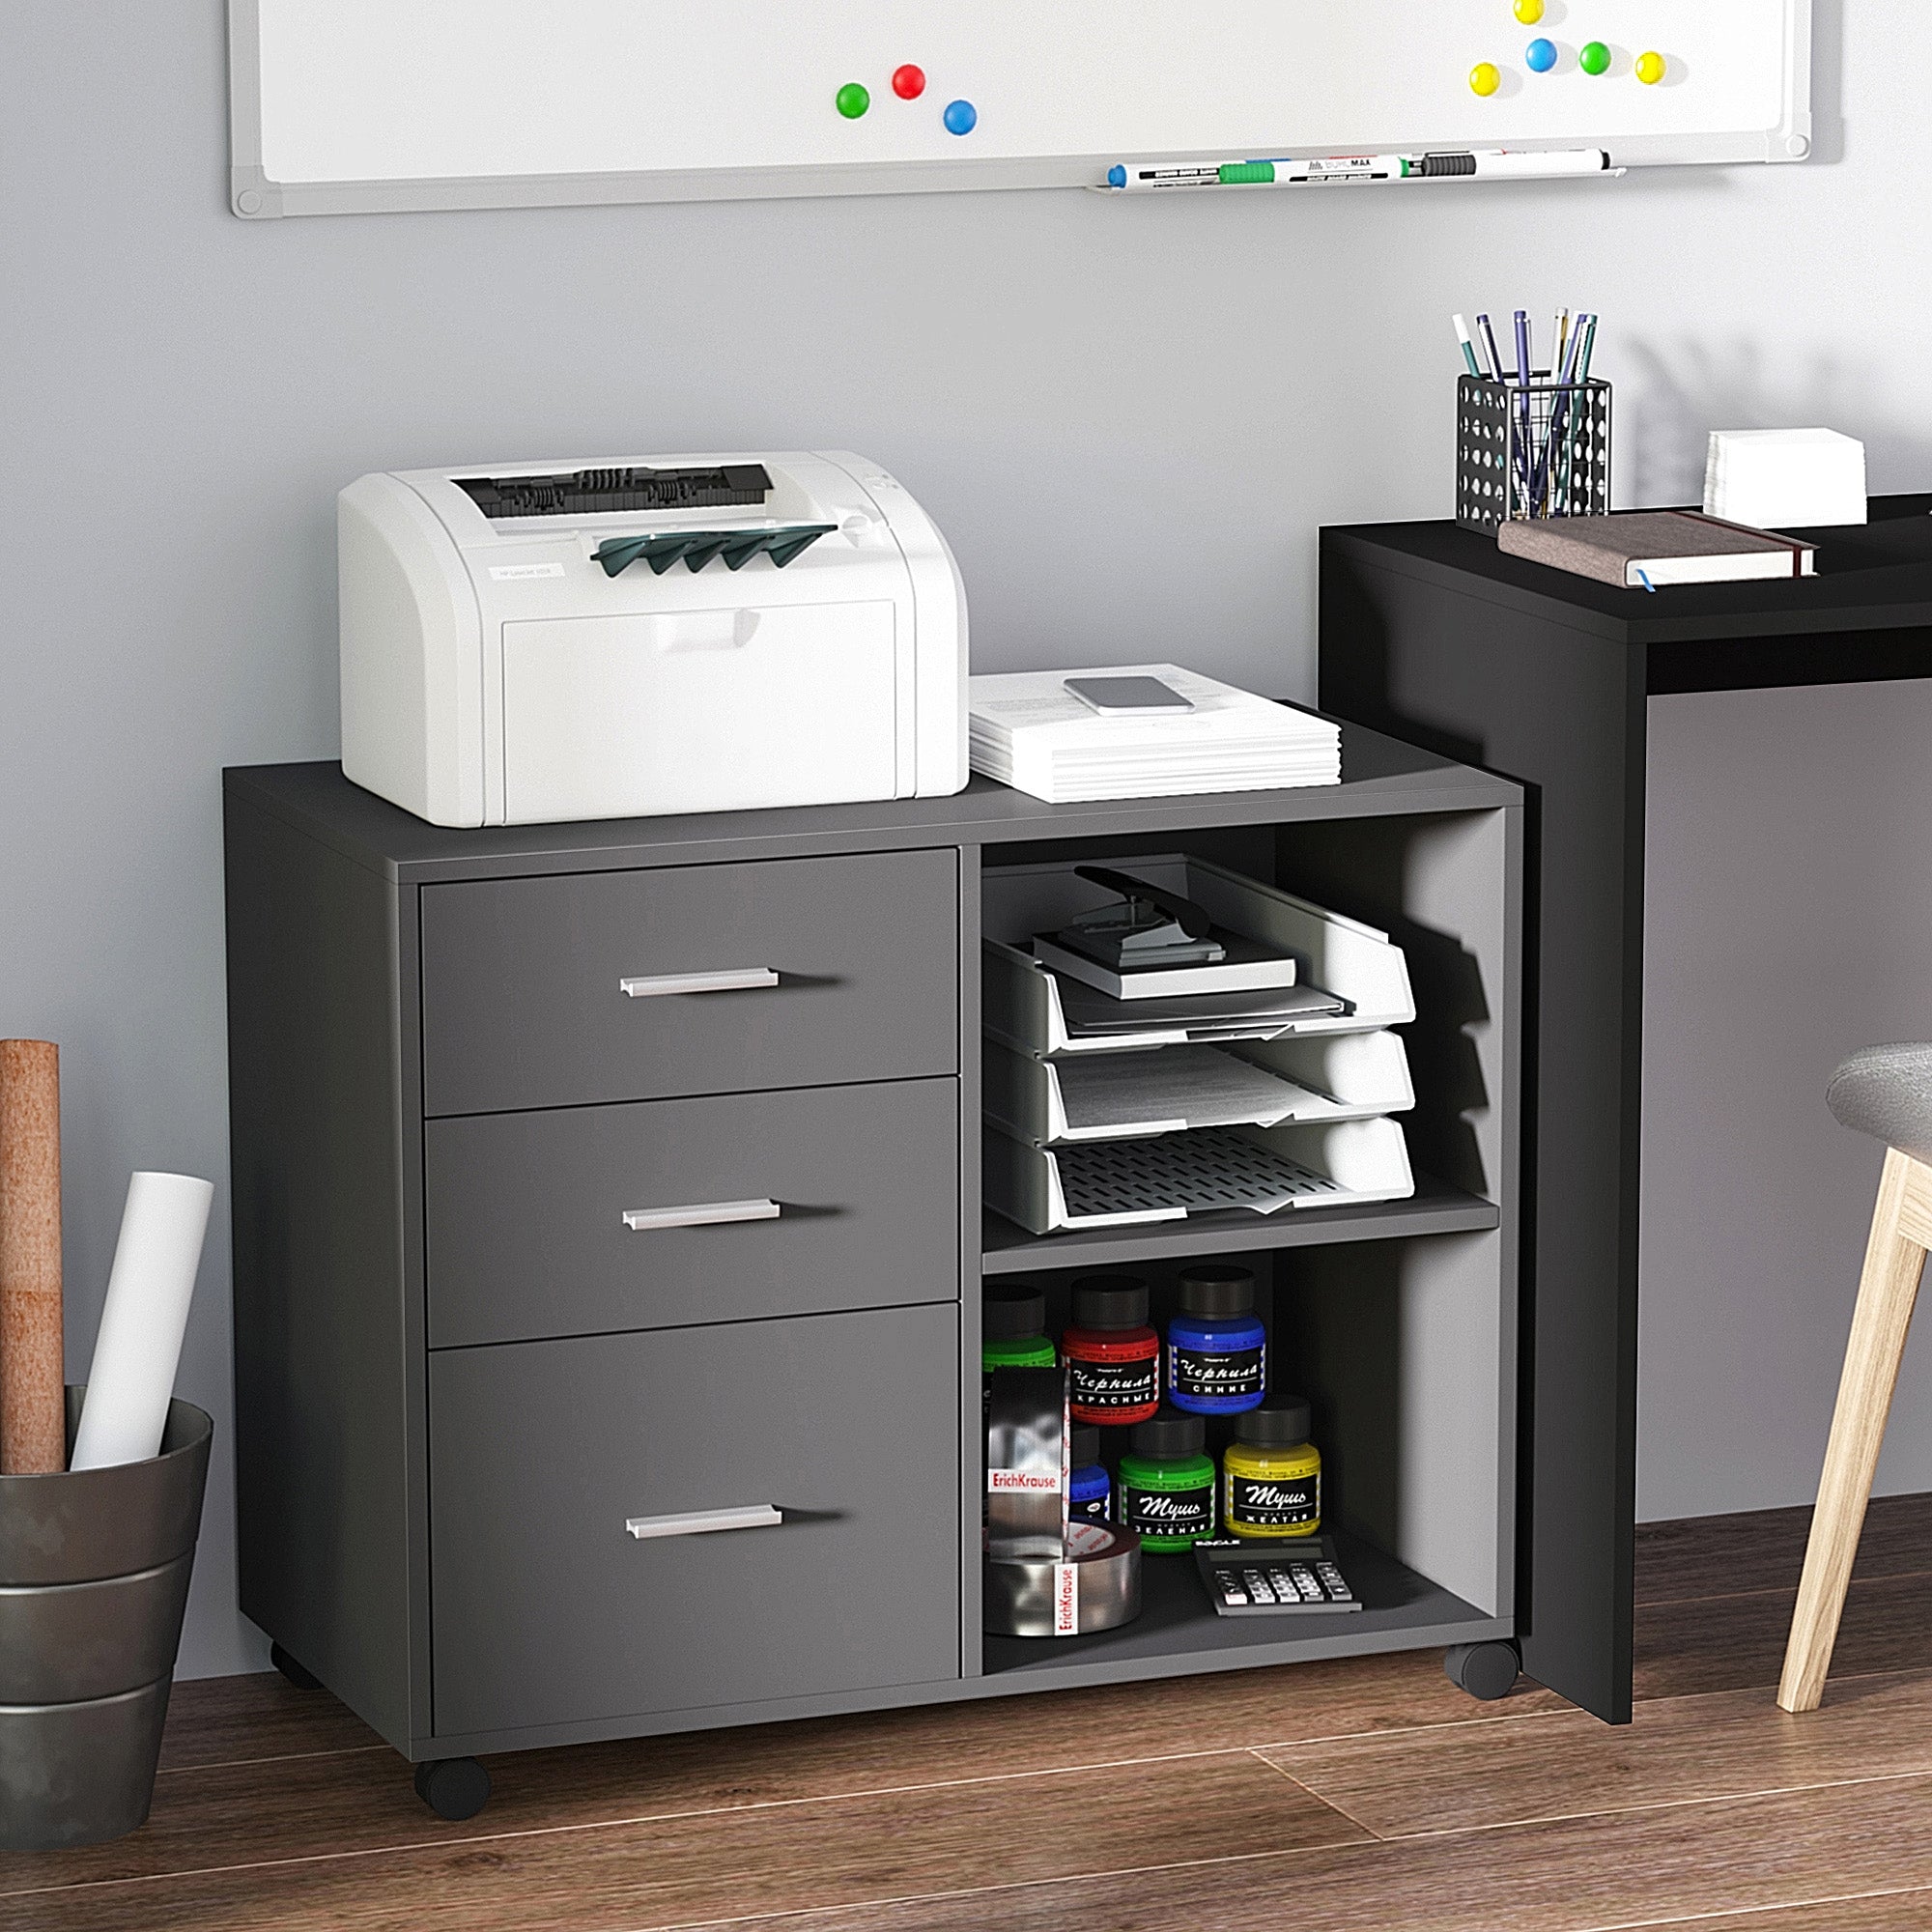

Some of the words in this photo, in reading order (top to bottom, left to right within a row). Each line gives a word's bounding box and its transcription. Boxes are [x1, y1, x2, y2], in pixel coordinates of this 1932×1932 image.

[1073, 1369, 1151, 1392] Чернила
[1180, 1359, 1258, 1381] Чернила
[1077, 1392, 1150, 1405] КРАСНЫЕ
[1192, 1383, 1246, 1394] СИНИЕ
[992, 1472, 1057, 1489] ErichKrause
[1139, 1496, 1201, 1520] Тушь
[1245, 1485, 1306, 1510] Тушь
[1059, 1569, 1072, 1632] ErichKrause
